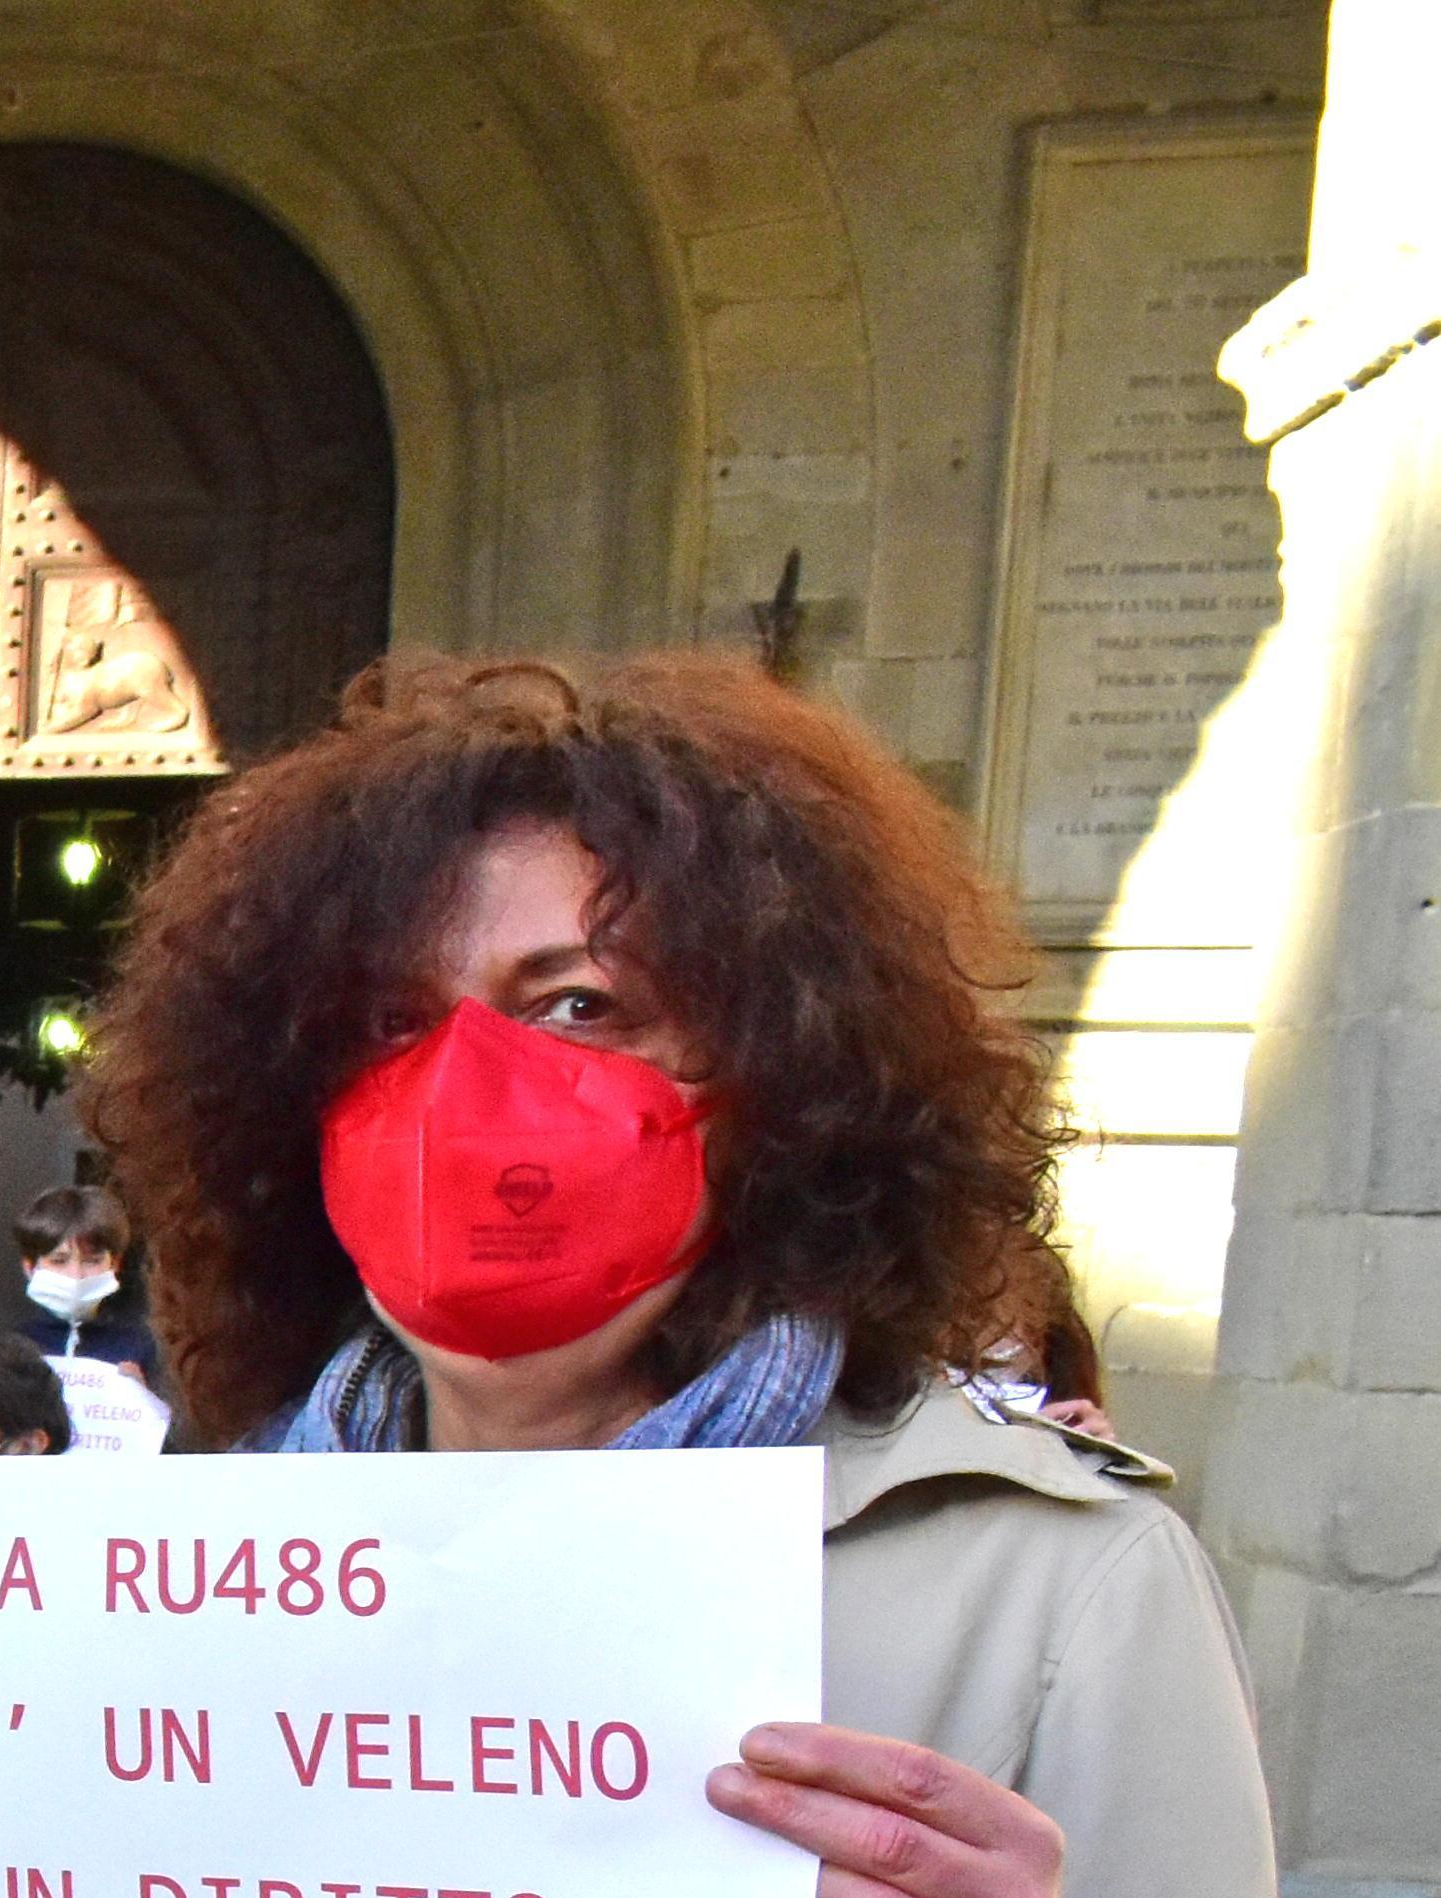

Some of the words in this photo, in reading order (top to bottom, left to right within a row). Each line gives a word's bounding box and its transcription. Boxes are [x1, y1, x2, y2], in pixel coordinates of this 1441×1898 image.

[83, 1404, 142, 1422] VELENO
[105, 1537, 388, 1617] RU486
[104, 1706, 212, 1784] UN
[277, 1711, 650, 1802] VELENO
